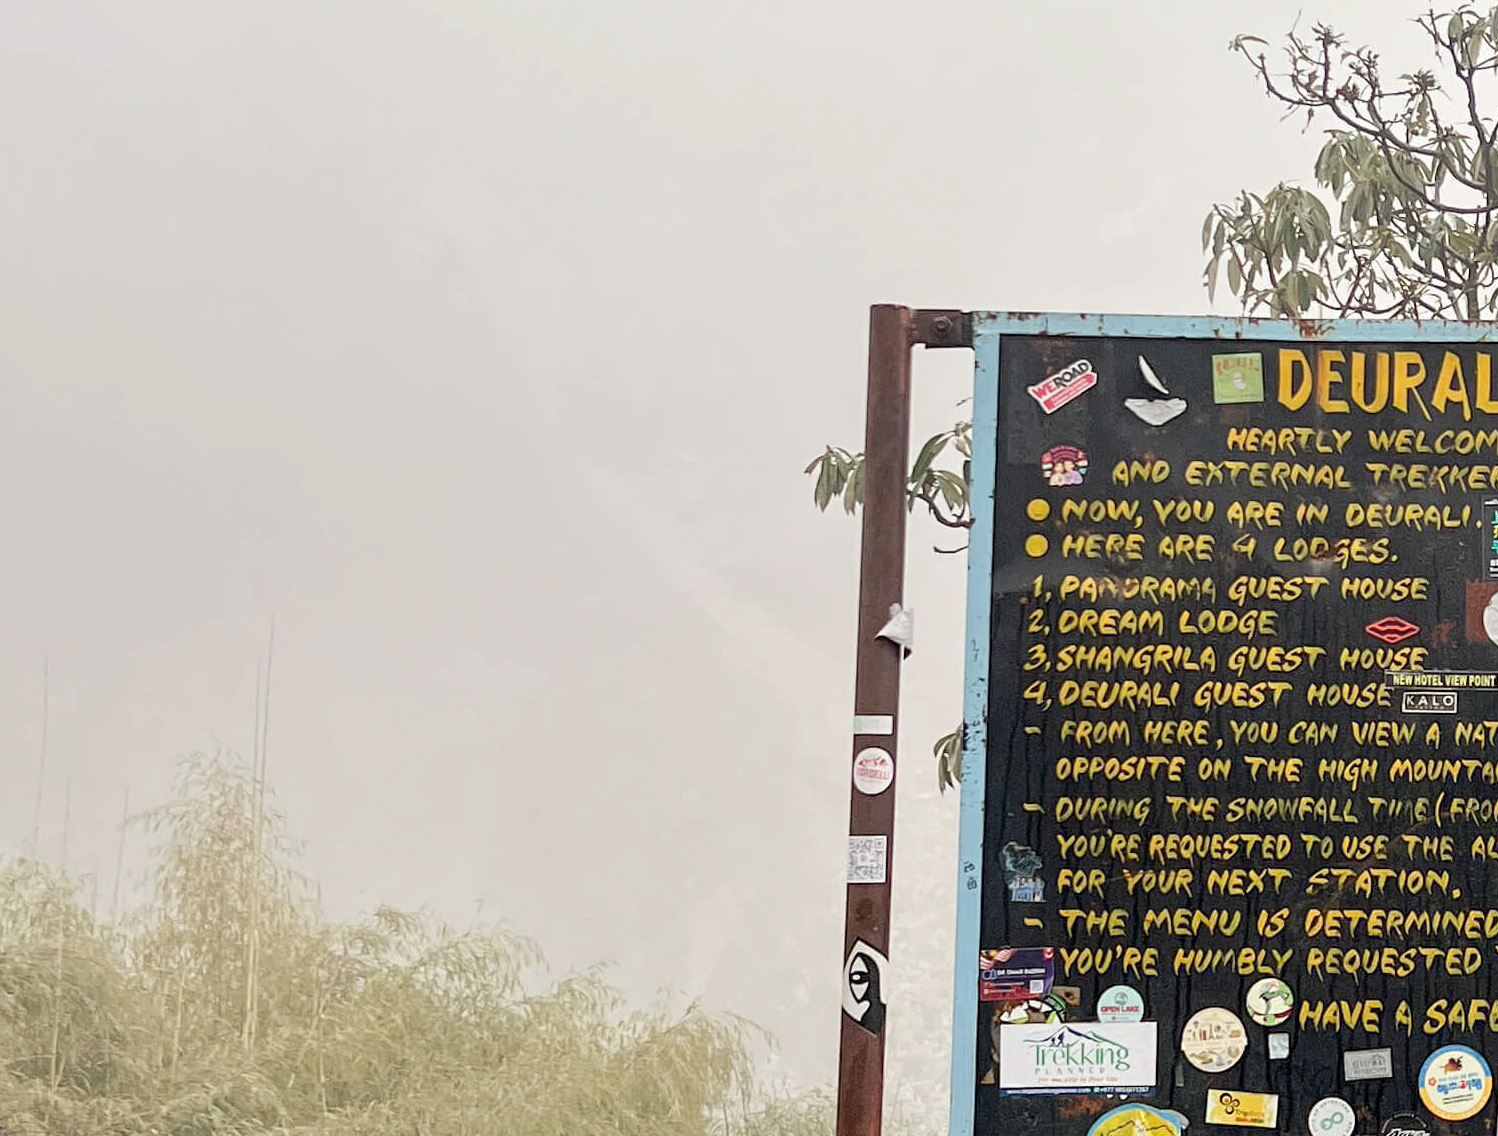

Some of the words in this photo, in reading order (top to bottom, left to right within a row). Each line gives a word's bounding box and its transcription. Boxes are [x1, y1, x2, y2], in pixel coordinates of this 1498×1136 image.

[1032, 361, 1090, 400] WEROAD
[1226, 426, 1352, 456] HEARTLY
[1111, 459, 1170, 486] AND
[1184, 460, 1352, 490] EXTERNAL
[1061, 500, 1144, 529] NOW,
[1152, 500, 1215, 525] YOU
[1226, 500, 1284, 530] ARE
[1295, 503, 1329, 525] IN
[1345, 502, 1483, 529] DEURALI.
[1061, 533, 1146, 560] HERE
[1158, 534, 1215, 561] ARE
[1231, 535, 1257, 559] 4
[1273, 536, 1398, 569] LODGES.
[1227, 575, 1329, 607] GUEST
[1340, 577, 1428, 602] HOUSE
[1058, 608, 1164, 636] DREAM
[1178, 609, 1276, 641] LODGE
[1055, 644, 1216, 676] SHANGRILA
[1227, 645, 1324, 678] GUEST
[1338, 646, 1428, 671] HOUSE
[1058, 680, 1180, 711] DEURALI
[1193, 680, 1293, 710] GUEST
[1306, 682, 1390, 708] HOUSE
[1393, 674, 1413, 686] NEW
[1414, 674, 1443, 686] HOTEL
[1444, 674, 1468, 686] VIEW
[1469, 675, 1496, 686] POINT
[1406, 695, 1454, 706] KALO
[1060, 720, 1130, 748] FROM
[1229, 719, 1279, 744] YOU
[1288, 720, 1338, 744] CAN
[1351, 721, 1415, 747] VIEW
[1425, 724, 1441, 747] A
[1055, 756, 1186, 782] OPPOSITE
[1198, 757, 1232, 781] ON
[1243, 756, 1304, 782] THE
[1318, 758, 1379, 792] HIGH
[1055, 796, 1152, 828] DURING
[1166, 796, 1220, 822] THE
[1225, 796, 1357, 824] SNOWFALL
[1056, 828, 1141, 862] YOU'RE
[1148, 833, 1292, 868] REQUESTED
[1300, 833, 1335, 862] TO
[1341, 835, 1390, 862] USE
[1400, 834, 1452, 861] THE
[1057, 868, 1106, 897] FOR
[1122, 868, 1193, 894] YOUR
[1207, 868, 1292, 895] NEXT
[1306, 868, 1461, 899] STATION.
[1058, 908, 1129, 936] THE
[1143, 908, 1242, 937] MENU
[1257, 908, 1290, 938] IS
[1058, 943, 1160, 980] YOU'RE
[1173, 948, 1293, 975] HUMBLY
[1306, 947, 1482, 977] REQUESTED
[1100, 1005, 1120, 1014] OPEN
[1298, 999, 1383, 1033] HAVE
[1394, 1001, 1414, 1038] A
[1033, 1041, 1131, 1072] Trekking
